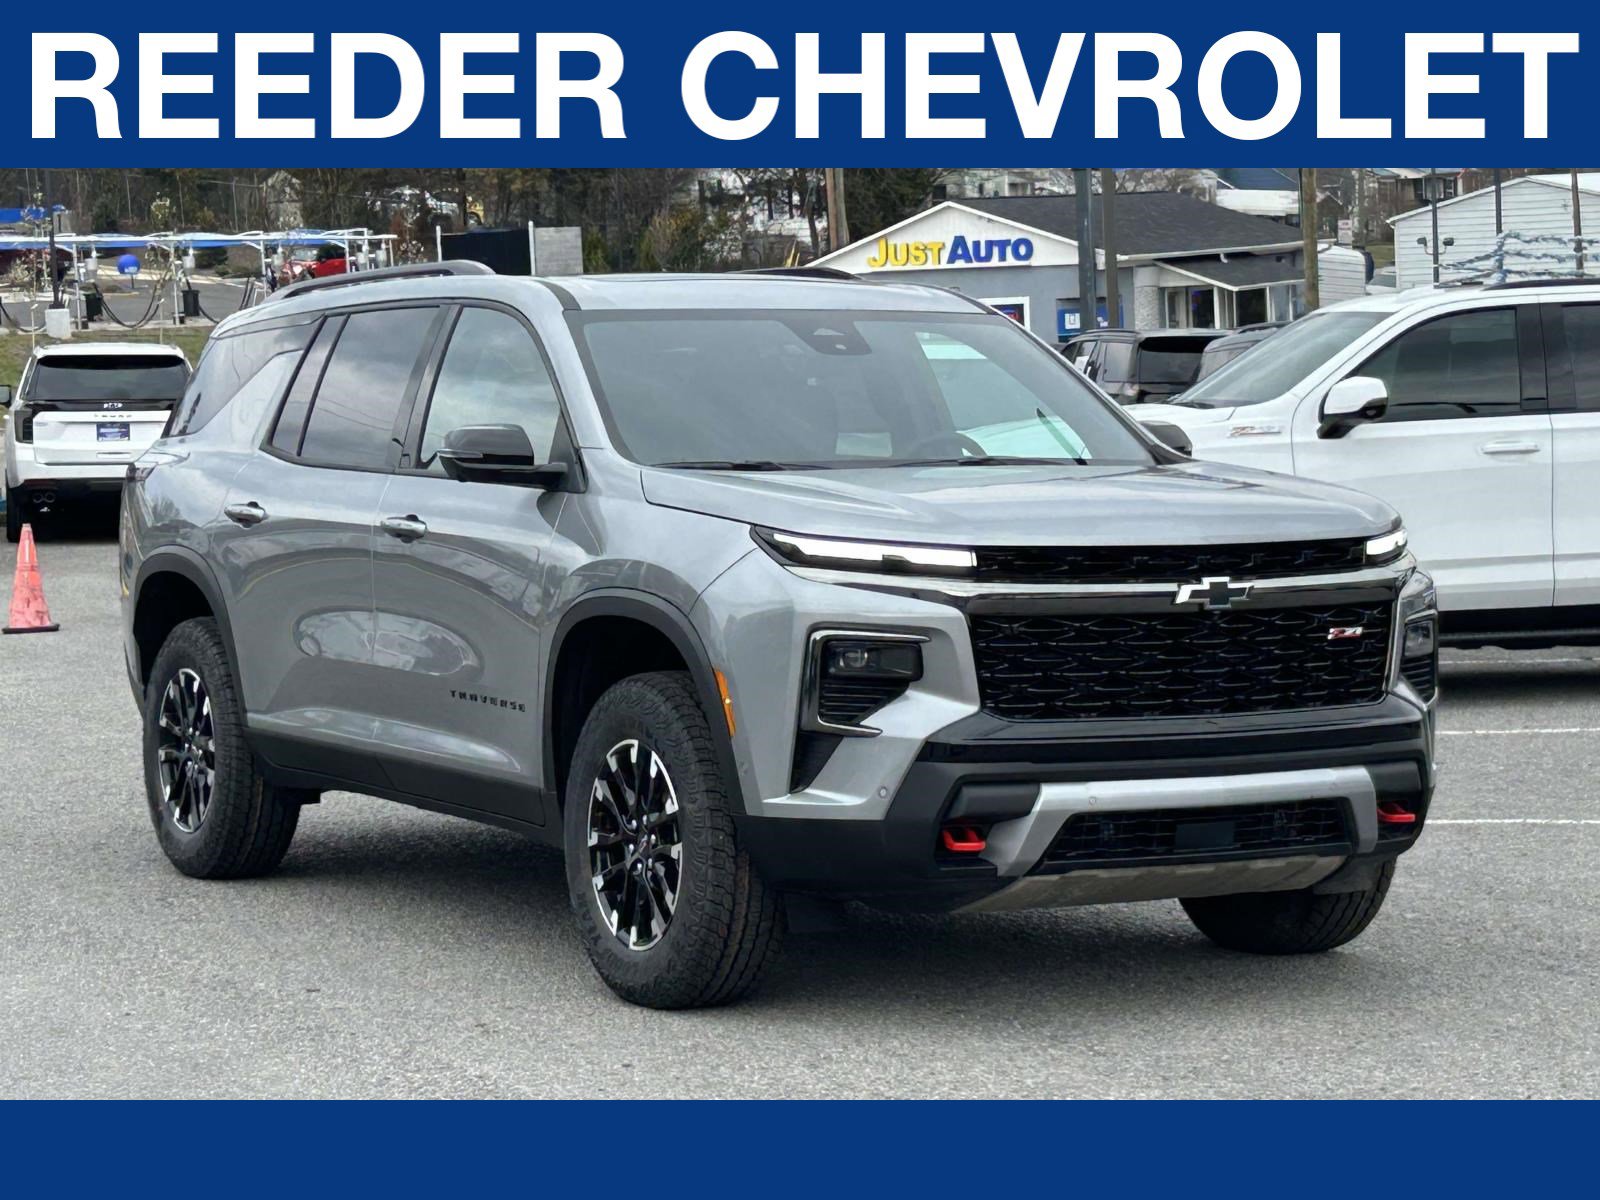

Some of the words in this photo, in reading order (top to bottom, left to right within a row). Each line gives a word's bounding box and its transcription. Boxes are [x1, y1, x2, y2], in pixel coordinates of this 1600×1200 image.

[868, 237, 944, 268] JUST
[946, 235, 1034, 265] AUTO
[450, 689, 526, 713] TRAVERSE
